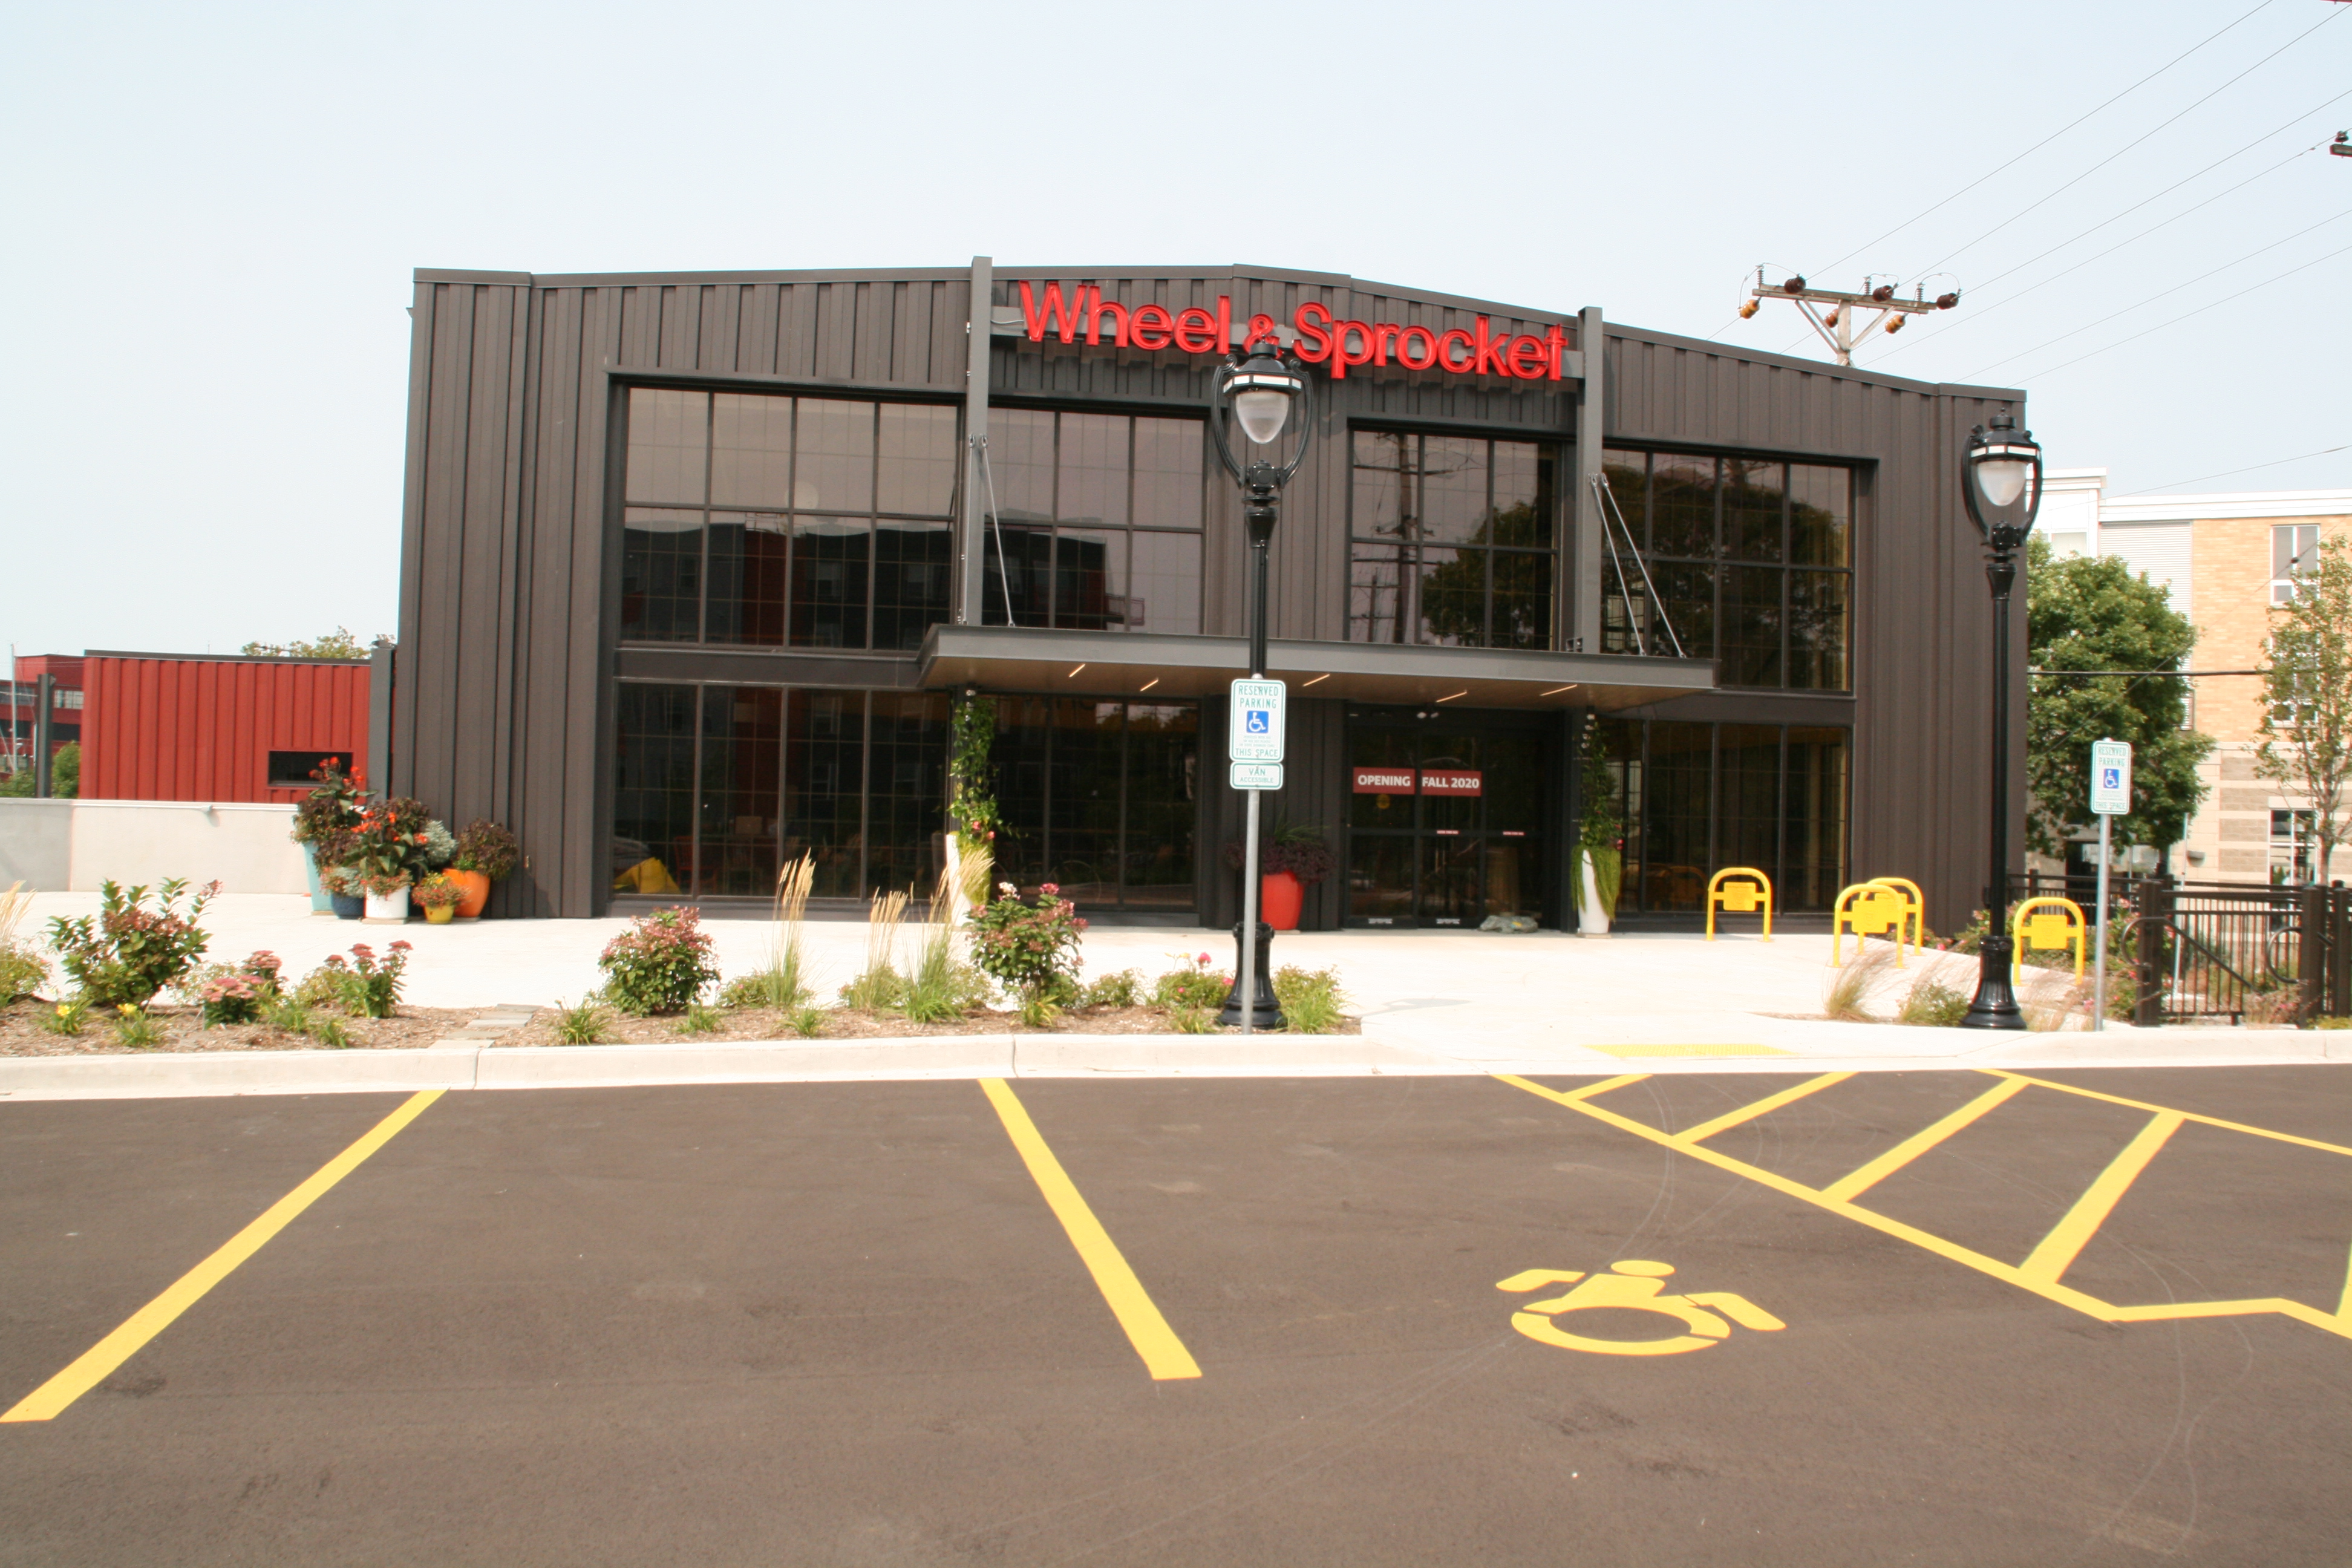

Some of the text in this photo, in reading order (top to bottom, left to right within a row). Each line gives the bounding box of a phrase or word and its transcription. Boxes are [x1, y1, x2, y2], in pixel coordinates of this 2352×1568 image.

[1019, 280, 1569, 382] Wheel & Sprocket
[1238, 685, 1279, 696] RESERVED
[1240, 697, 1277, 709] PARKING
[1235, 748, 1278, 757] THIS SPACE
[2098, 746, 2127, 756] RESERVED
[2099, 757, 2125, 766] PARKING
[1249, 768, 1266, 776] VAN
[1357, 774, 1411, 786] OPENING
[1422, 777, 1480, 789] FALL 2020
